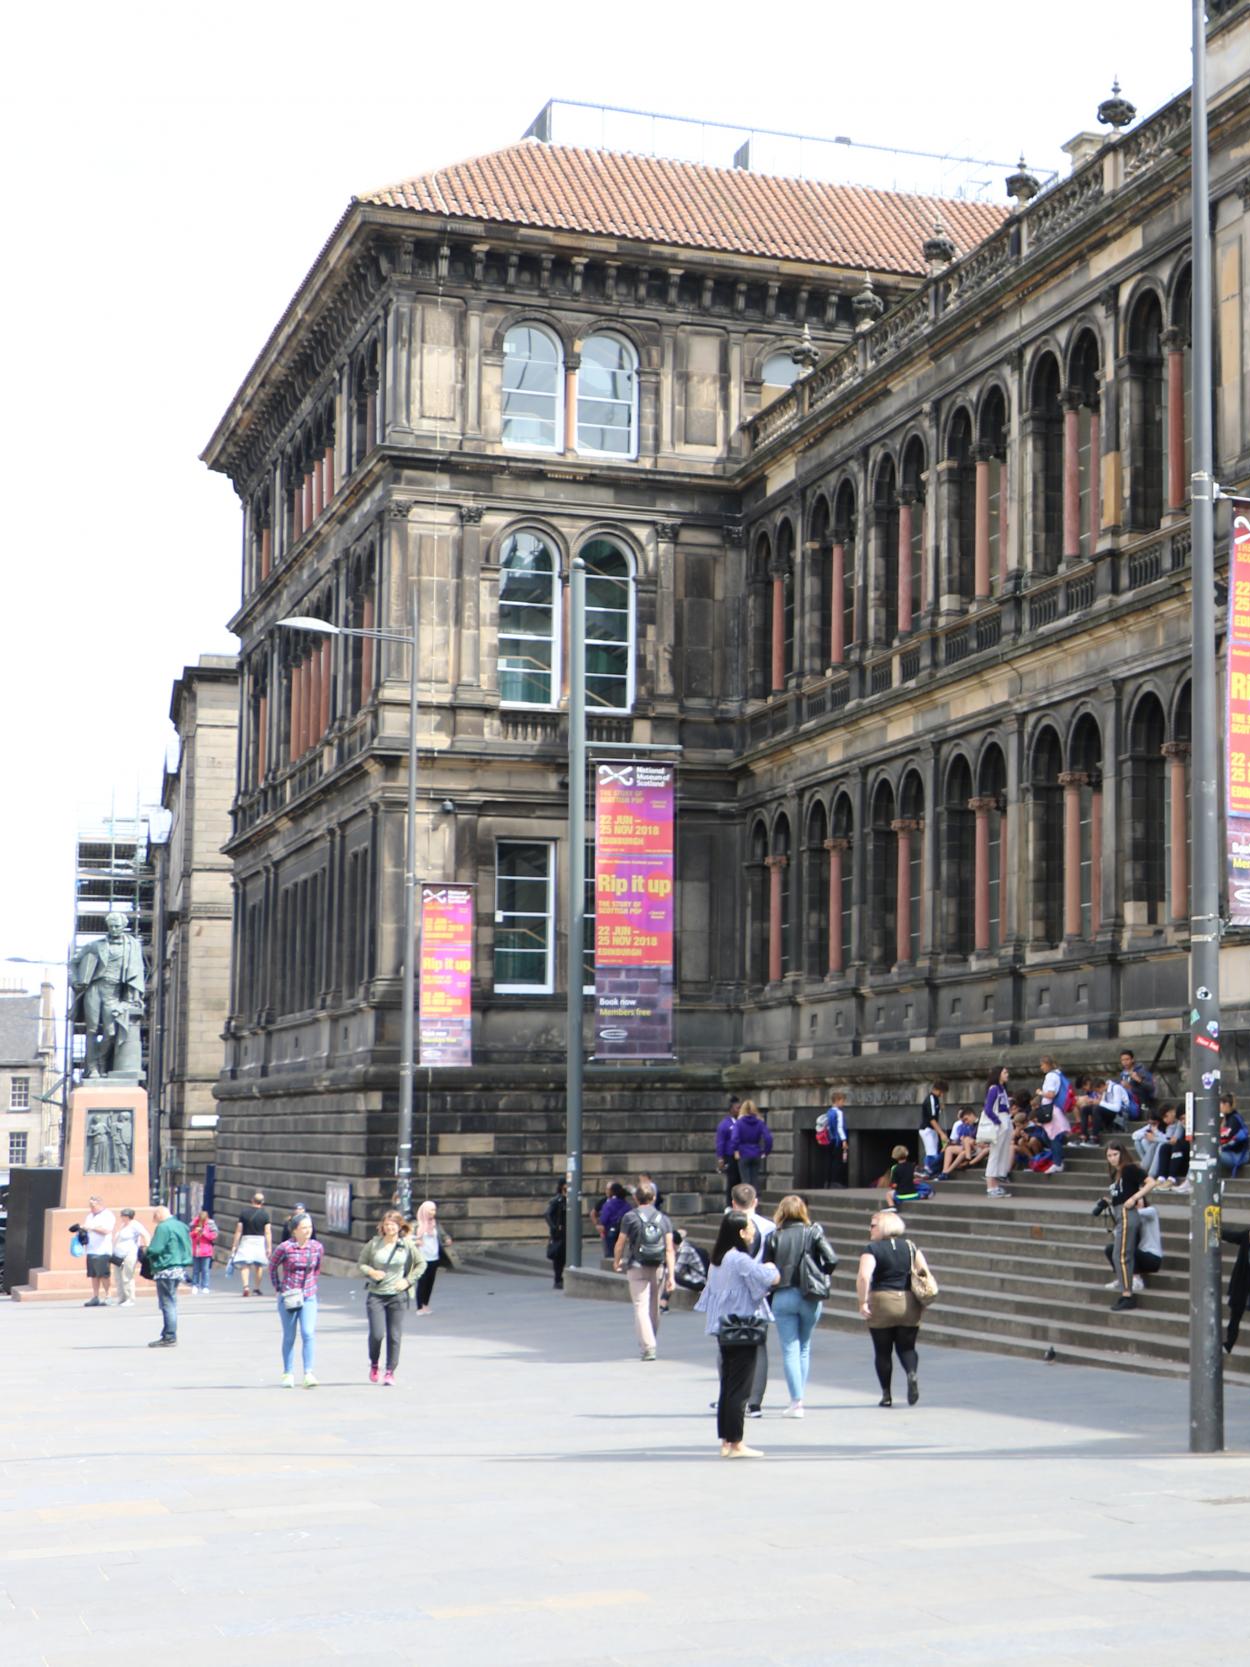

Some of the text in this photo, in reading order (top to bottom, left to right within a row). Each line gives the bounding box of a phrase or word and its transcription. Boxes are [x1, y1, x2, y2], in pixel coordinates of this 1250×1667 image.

[1235, 581, 1250, 596] 22
[1234, 597, 1250, 612] 25
[1232, 713, 1245, 724] THE
[1231, 752, 1245, 767] 22
[1231, 768, 1245, 782] 25
[600, 815, 612, 824] 22
[614, 816, 633, 824] JUN
[600, 825, 660, 835] 25 NOV 2018
[598, 874, 671, 897] Rip it up
[598, 926, 610, 935] 22
[612, 926, 631, 935] JUN
[598, 936, 657, 946] 25 NOV 2018
[600, 1008, 651, 1016] Members free
